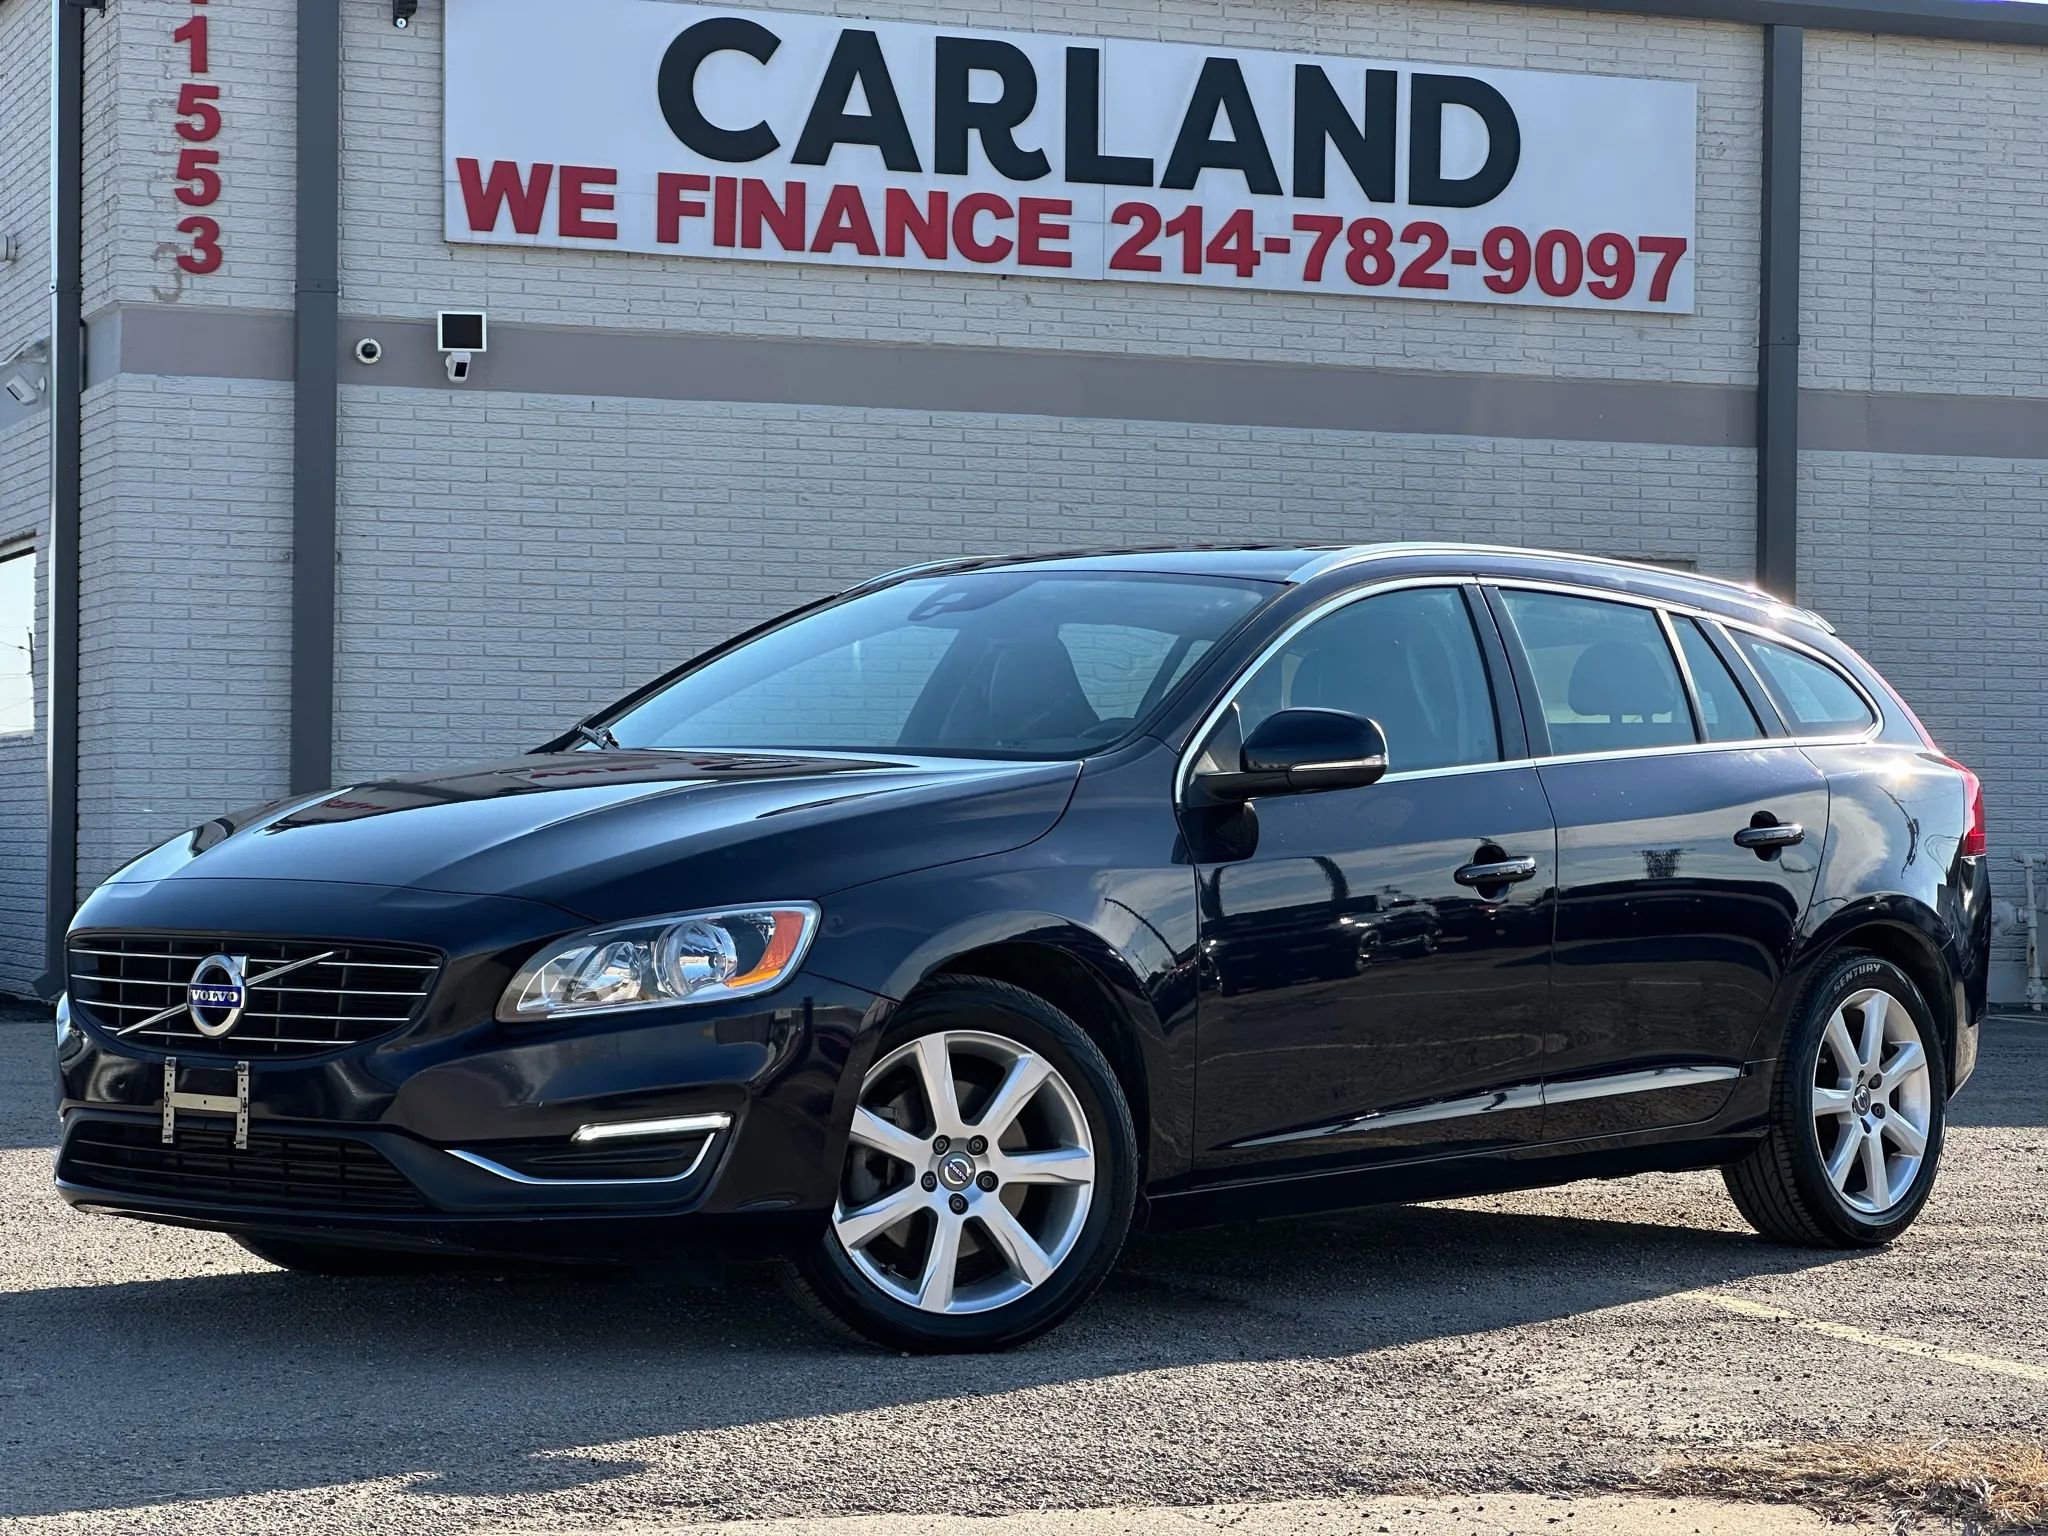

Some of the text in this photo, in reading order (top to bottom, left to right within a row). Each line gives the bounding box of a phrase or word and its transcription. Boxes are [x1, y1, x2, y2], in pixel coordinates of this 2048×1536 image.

[174, 0, 222, 274] 1553
[656, 17, 1522, 208] CARLAND
[456, 157, 1688, 302] WE FINANCE 214-782-9097
[190, 989, 239, 1003] VOLVO
[1833, 963, 1881, 994] SENTURY
